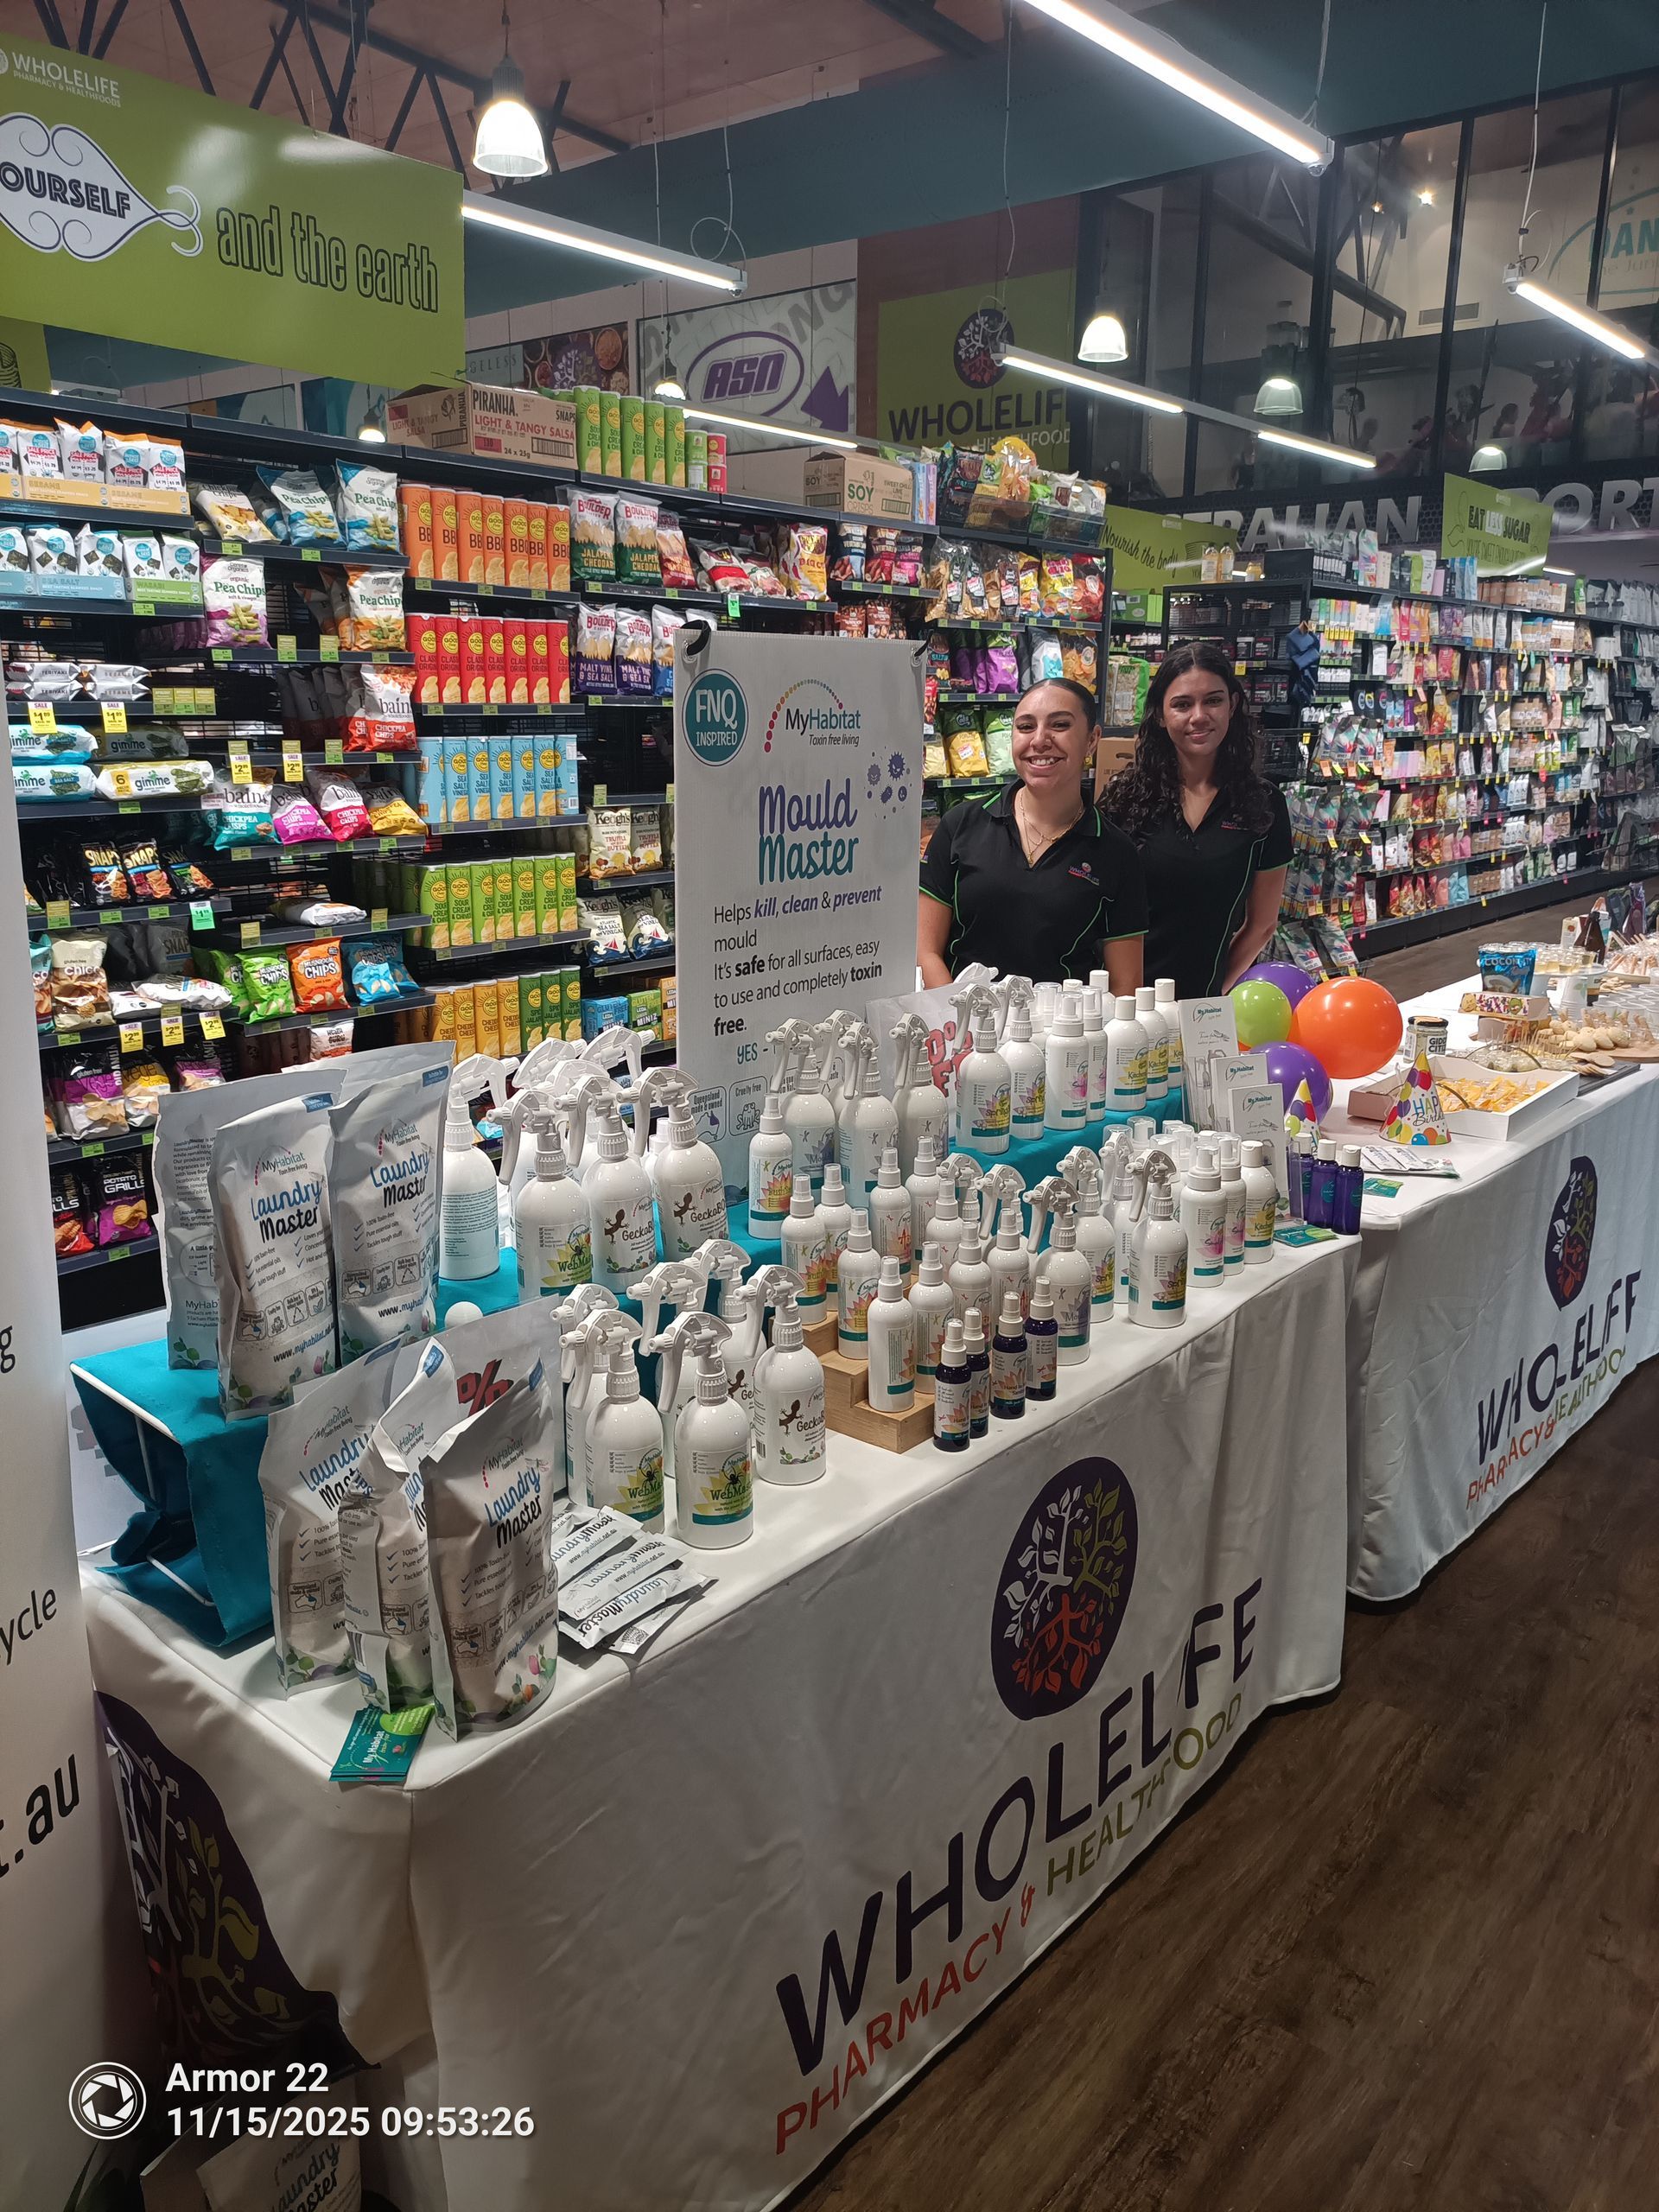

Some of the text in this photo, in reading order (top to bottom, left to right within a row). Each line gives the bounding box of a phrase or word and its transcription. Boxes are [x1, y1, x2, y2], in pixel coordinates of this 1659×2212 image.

[12, 52, 120, 99] WHOLELIFE
[13, 69, 56, 90] PHARMACY
[66, 86, 121, 108] HEALTHFOODS
[216, 205, 439, 314] and the earth
[475, 414, 504, 431] LIGHT
[516, 421, 548, 435] TANGY
[550, 426, 575, 441] SALSA
[888, 388, 1071, 443] WHOLELIF
[355, 493, 375, 505] Pea
[847, 483, 874, 502] SOY
[1468, 505, 1485, 532] EAT
[1503, 516, 1531, 544] SUGAR
[1102, 524, 1141, 562] Nourish
[1141, 544, 1155, 568] the
[213, 581, 267, 597] Pea Chips
[359, 595, 378, 607] Pea
[580, 662, 599, 672] MALT
[587, 672, 599, 681] SEA
[695, 689, 738, 729] FNQ
[785, 707, 861, 736] MyHabitat
[111, 737, 146, 753] gimme
[695, 731, 738, 747] INSPIRED
[809, 734, 860, 748] Toxin free living
[116, 773, 125, 785] 6
[135, 775, 171, 791] gimme
[758, 777, 859, 836] Mould
[758, 830, 860, 886] Master
[582, 899, 619, 913] Keogh's
[714, 884, 882, 925] Helps kill, clean & prevent
[714, 928, 758, 953] mould
[304, 963, 338, 979] CHIPS
[714, 938, 880, 982] It's safe for all surfaces, easy
[714, 961, 882, 1009] to use and completely toxin
[714, 1016, 747, 1037] free.
[736, 1042, 759, 1065] YES
[693, 1089, 721, 1106] Queensland
[752, 1083, 762, 1096] free
[384, 1123, 419, 1143] MyHabitat
[261, 1152, 305, 1173] MyHabitat
[369, 1150, 430, 1189] Laundry
[251, 1179, 322, 1222] Laundry
[383, 1174, 427, 1209] Master
[259, 1205, 319, 1244] Master
[484, 1465, 542, 1528] Laundry
[495, 1494, 543, 1549] Master
[773, 1904, 1013, 2156] PHARMACY
